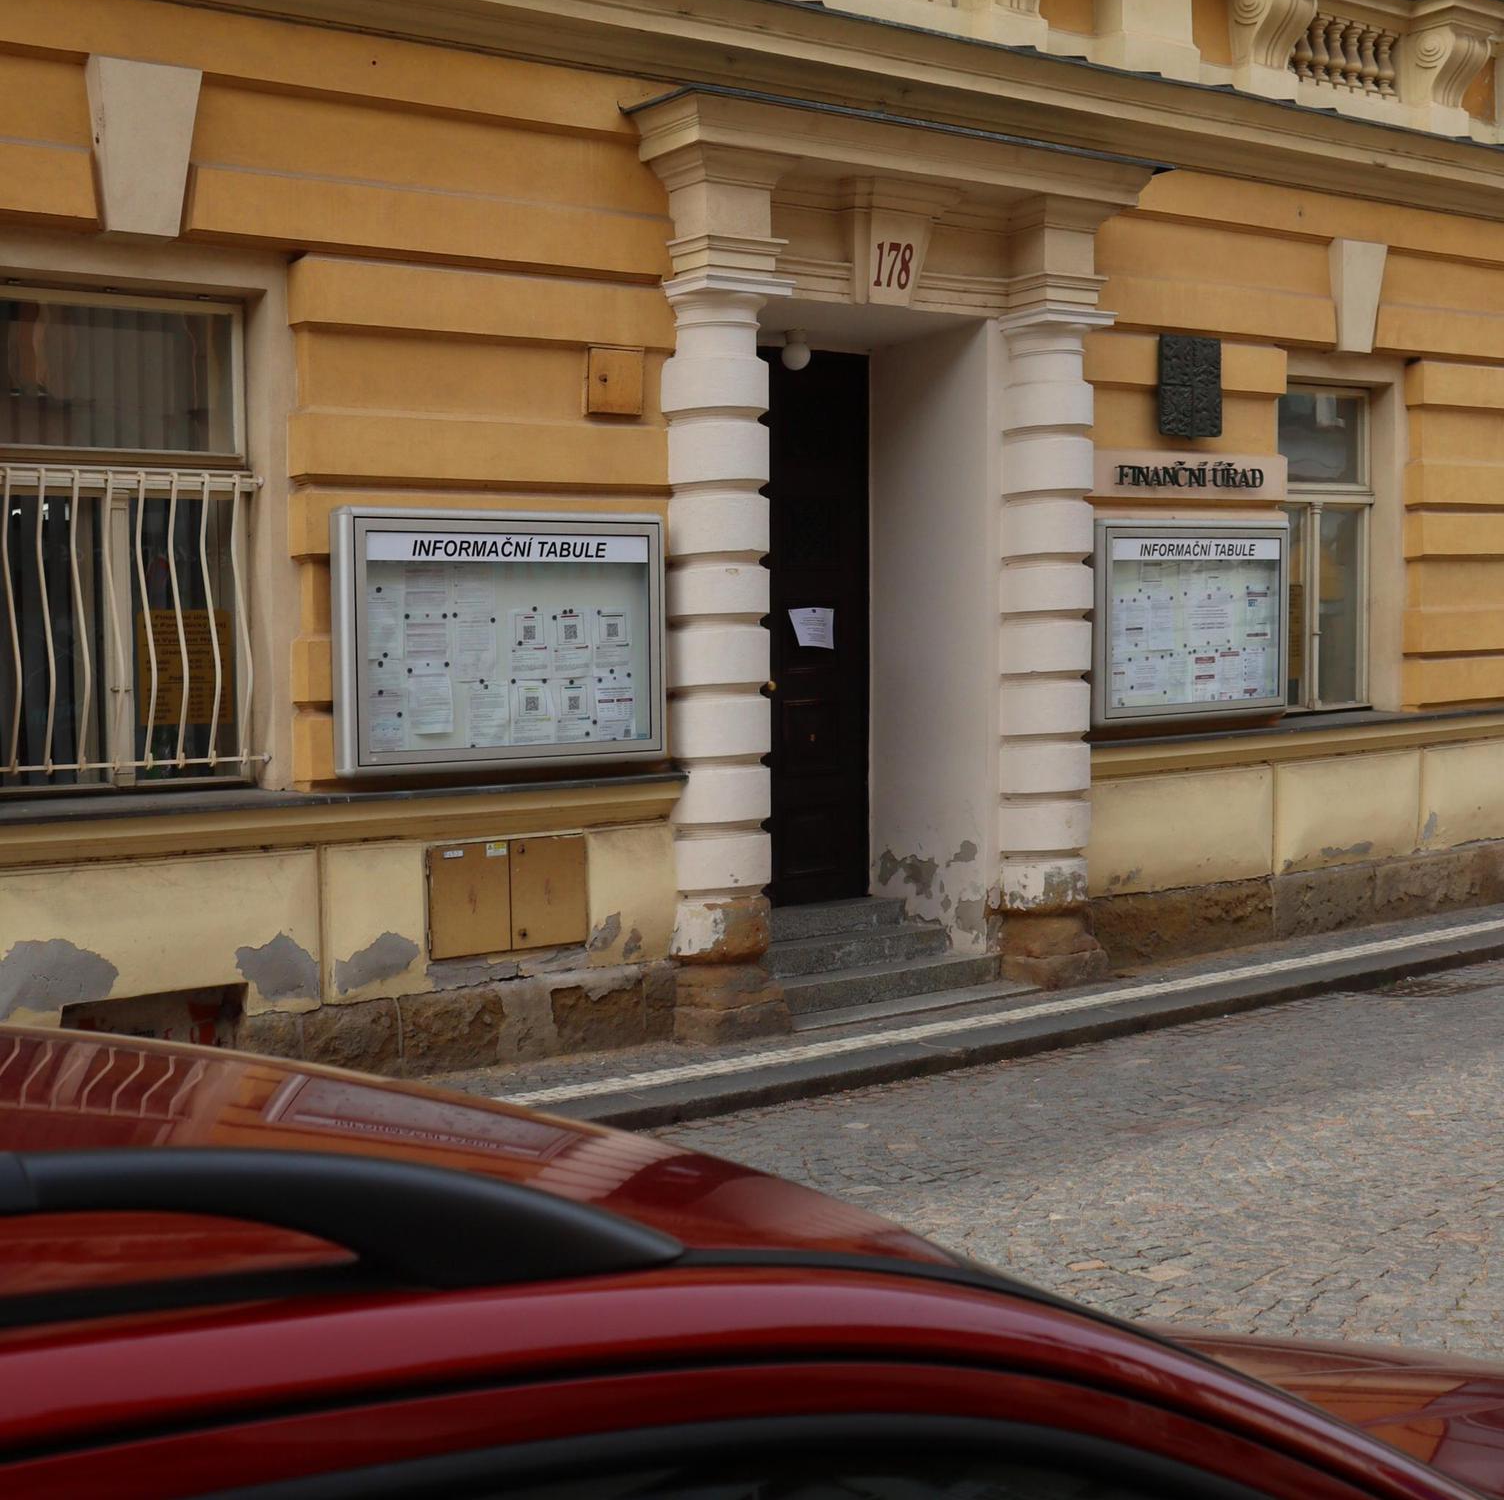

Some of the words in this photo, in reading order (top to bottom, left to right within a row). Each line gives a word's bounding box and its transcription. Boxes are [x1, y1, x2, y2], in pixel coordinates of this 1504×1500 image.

[873, 241, 914, 290] 178
[1115, 461, 1208, 487] FINANČNÍ
[1209, 461, 1264, 488] ÚŘAD
[412, 537, 533, 558] INFORMAČNÍ
[538, 541, 607, 558] TABULE
[1140, 540, 1212, 557] INFORMAČNÍ
[1214, 544, 1256, 557] TABULE
